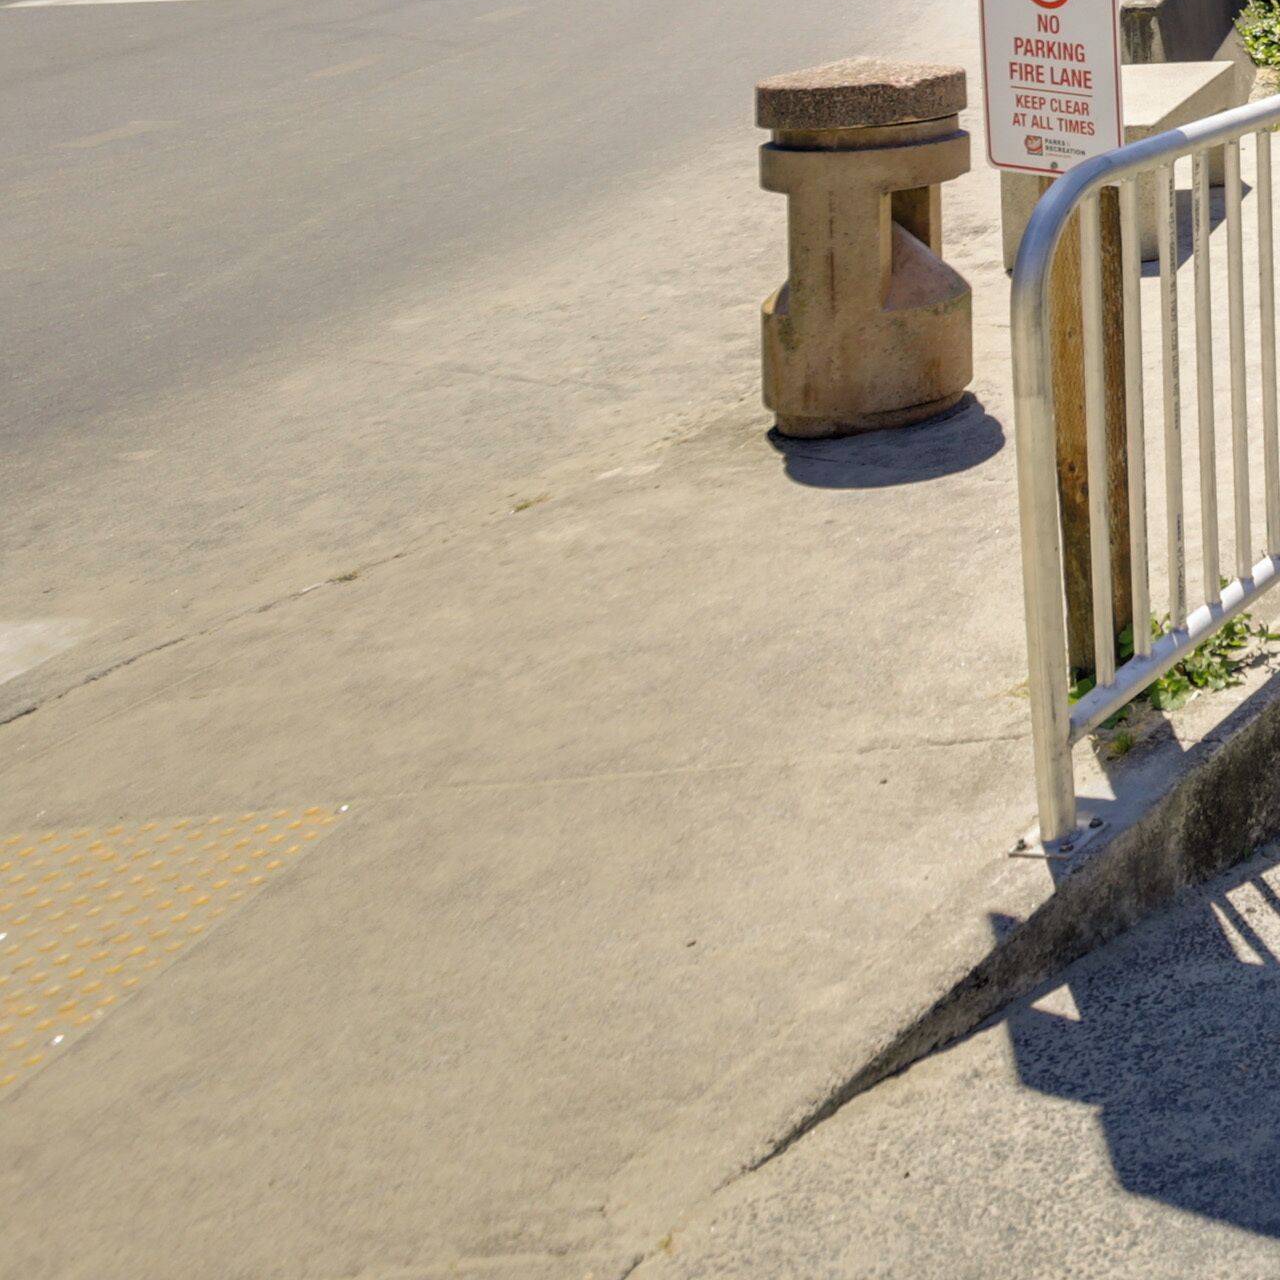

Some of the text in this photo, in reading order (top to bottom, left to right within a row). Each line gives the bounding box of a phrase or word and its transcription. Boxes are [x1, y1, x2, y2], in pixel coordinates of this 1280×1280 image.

[1037, 13, 1060, 34] NO
[1014, 37, 1085, 63] PARKING
[1009, 61, 1093, 89] FIRE LANE
[1015, 94, 1090, 116] KEEP CLEAR
[1012, 112, 1095, 136] AT ALL TIMES
[1045, 138, 1066, 146] PARKS
[1045, 145, 1086, 156] RECREATION
